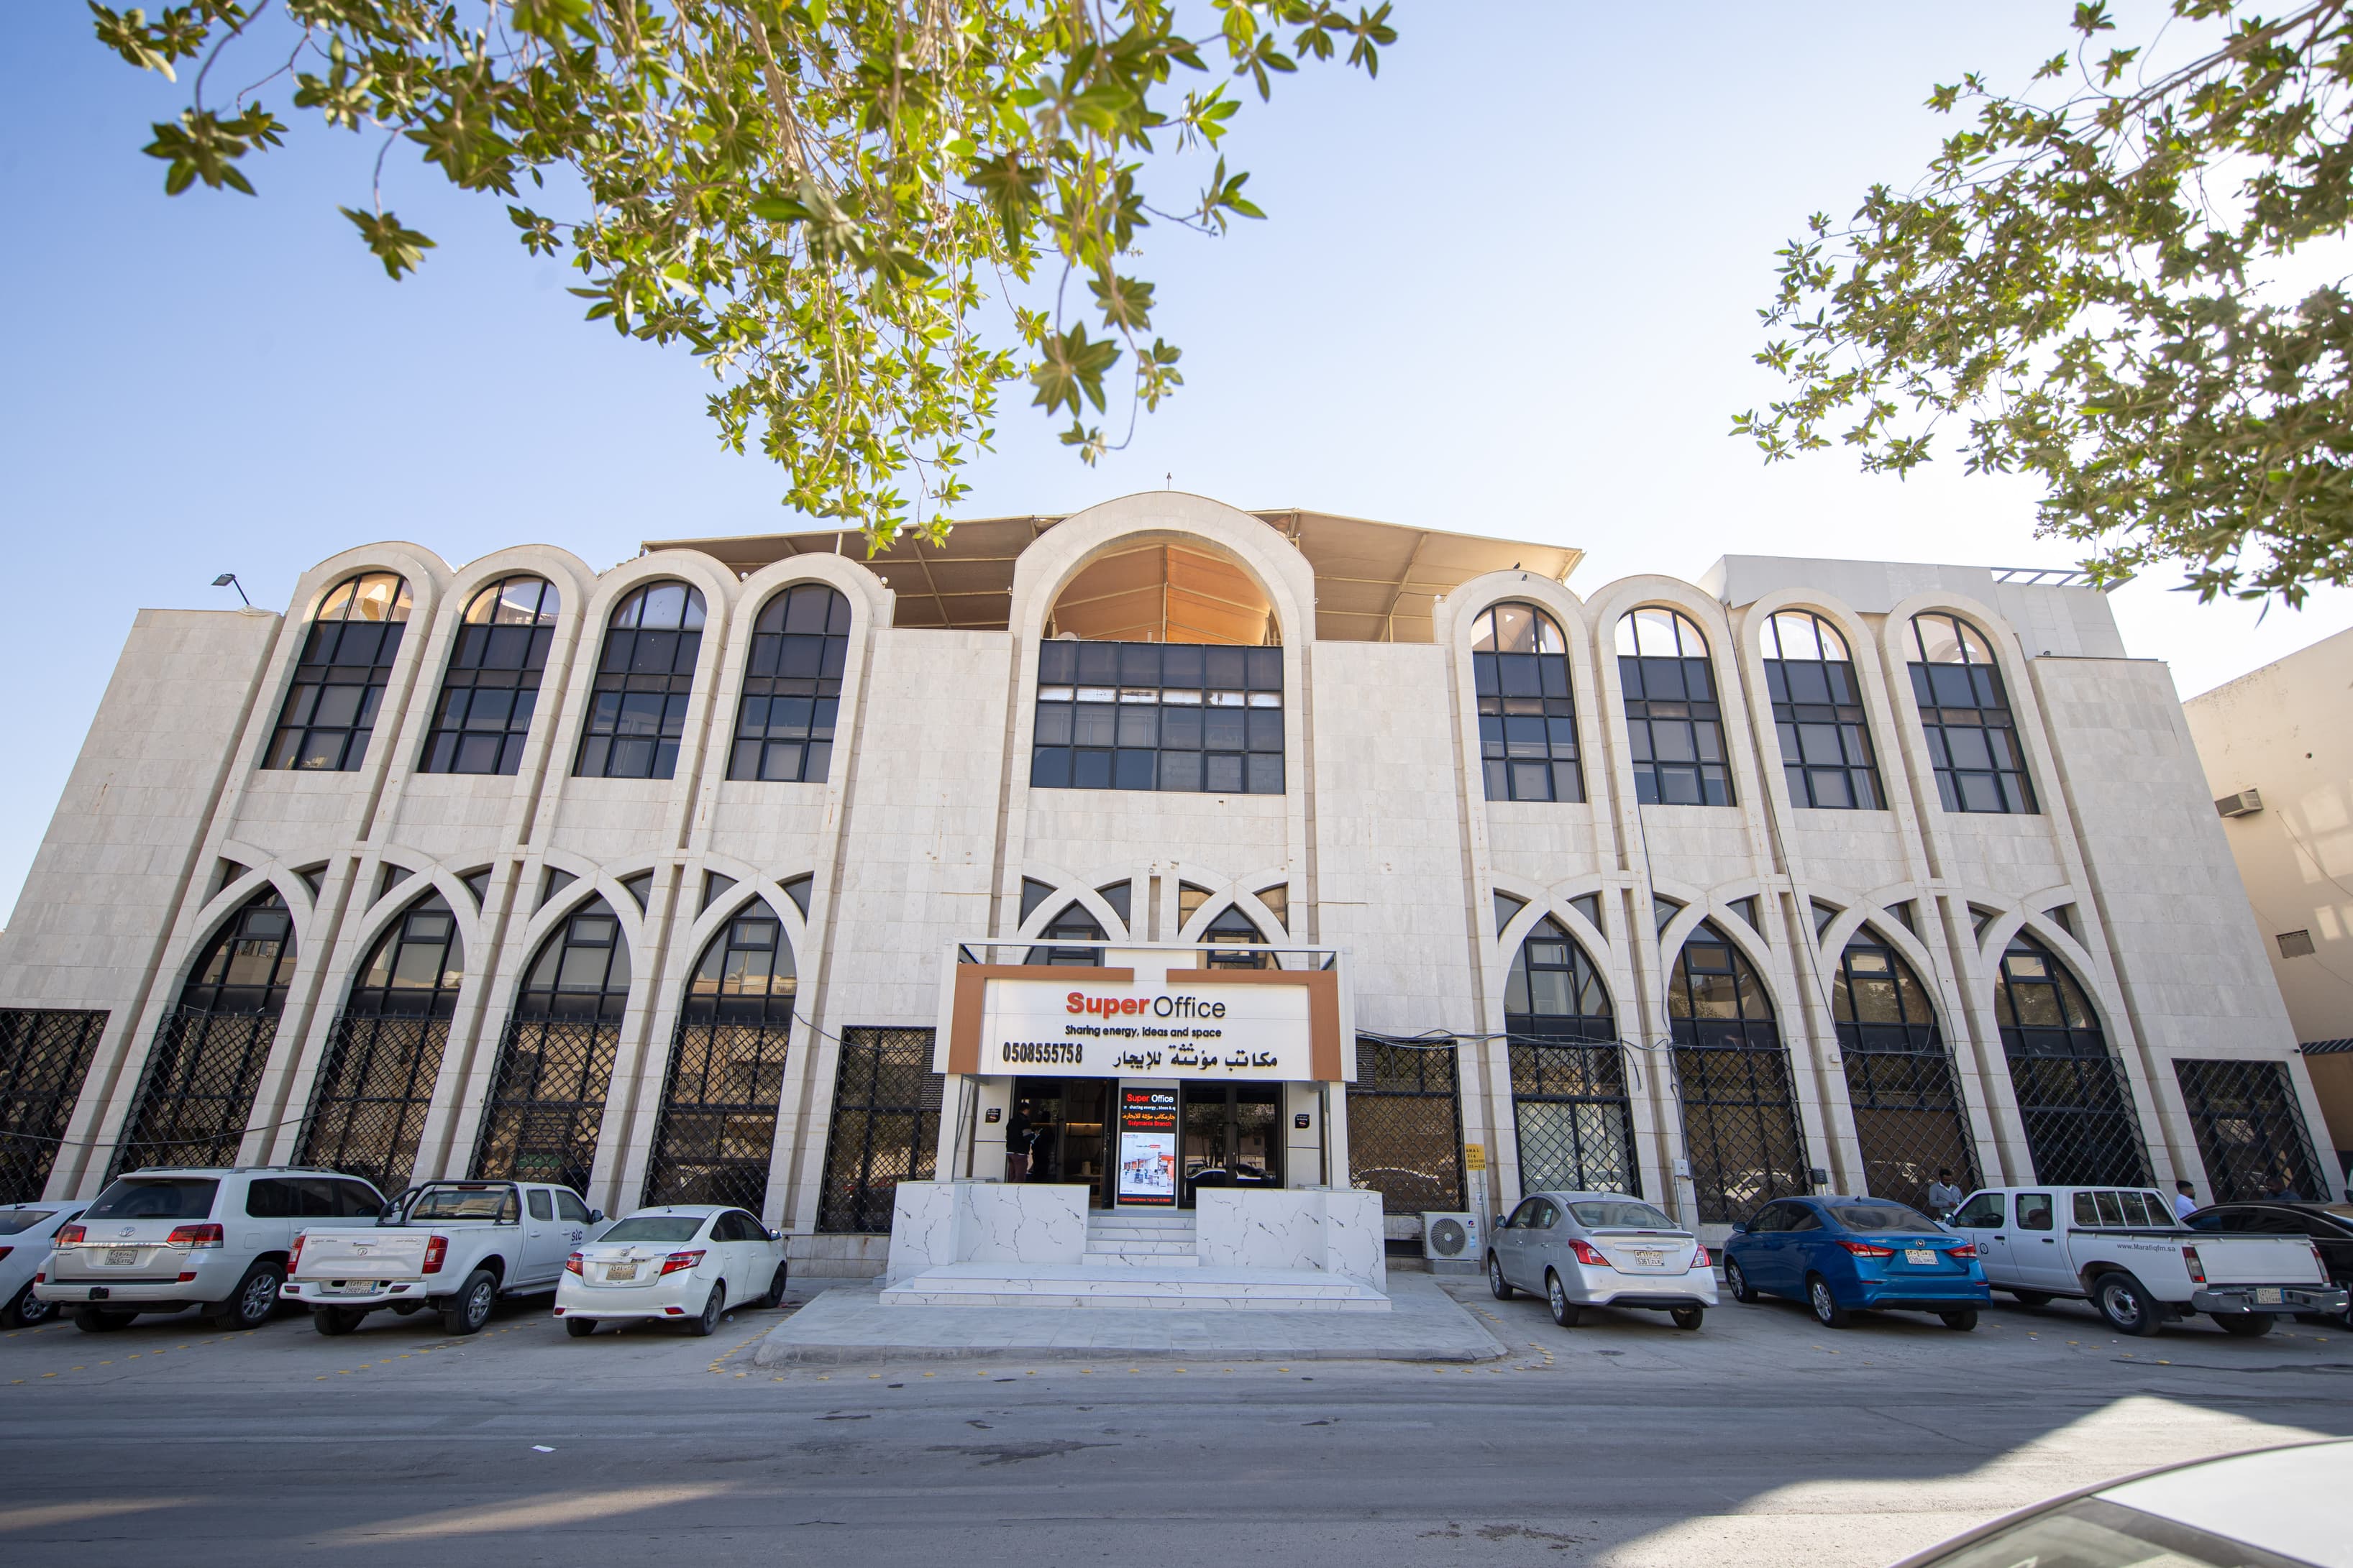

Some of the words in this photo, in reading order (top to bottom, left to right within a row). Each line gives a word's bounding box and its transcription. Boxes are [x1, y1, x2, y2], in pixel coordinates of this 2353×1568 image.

[1066, 991, 1151, 1019] Super
[1153, 996, 1226, 1018] Office
[1065, 1024, 1100, 1037] Sharing
[1102, 1027, 1140, 1037] energy,
[1142, 1027, 1169, 1037] ideas
[1170, 1027, 1189, 1037] and
[1192, 1028, 1222, 1038] space
[1002, 1042, 1083, 1063] 0508555758
[1112, 1050, 1162, 1070] للإيجار
[1168, 1042, 1217, 1070] مؤثثة
[1225, 1050, 1278, 1071] مكاتب
[1127, 1094, 1150, 1103] Super
[1151, 1094, 1174, 1103] Office
[572, 1228, 582, 1242] stc
[2116, 1243, 2176, 1252] www.Marafiqfm.sa
